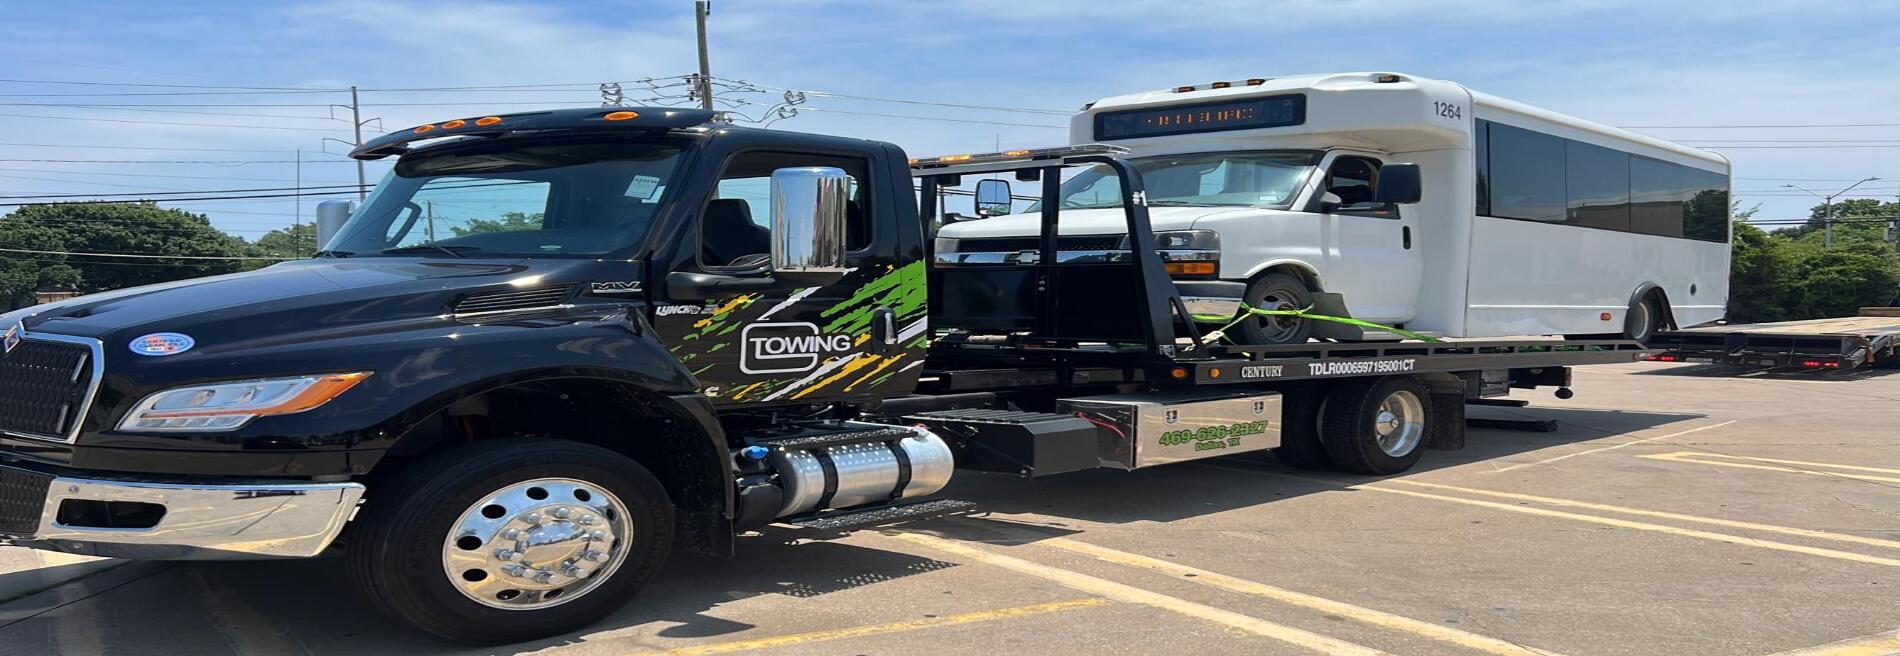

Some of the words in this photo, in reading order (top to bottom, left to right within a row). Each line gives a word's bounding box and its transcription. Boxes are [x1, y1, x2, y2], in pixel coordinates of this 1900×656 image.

[1433, 101, 1461, 120] 1264
[749, 334, 851, 355] TOWING
[1241, 365, 1283, 378] CENTURY
[1308, 359, 1416, 376] TDLR0006597195001CT
[1159, 420, 1269, 446] 469-626-2327
